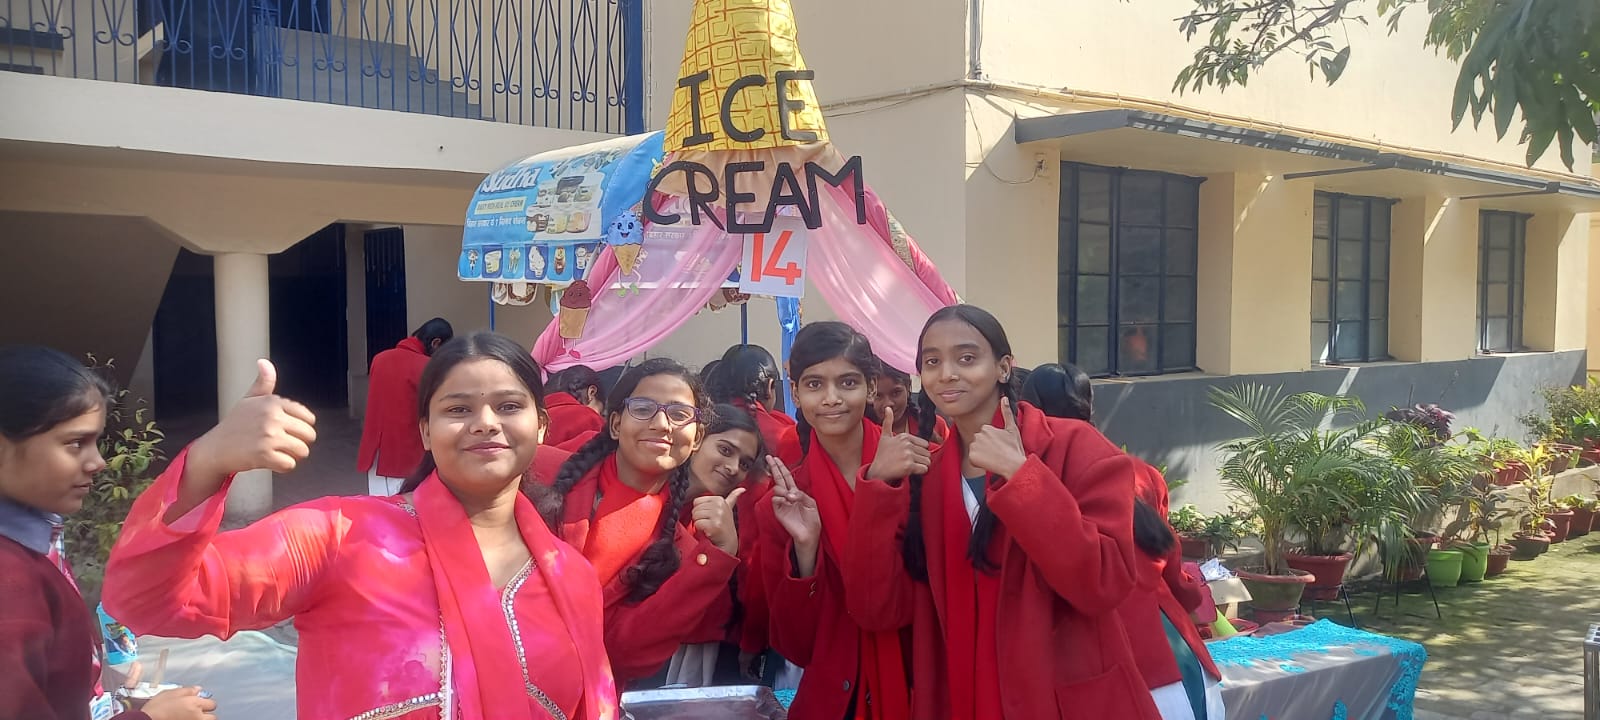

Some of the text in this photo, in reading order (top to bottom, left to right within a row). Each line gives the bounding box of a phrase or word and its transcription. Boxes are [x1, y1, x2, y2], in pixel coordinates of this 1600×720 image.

[679, 70, 818, 147] ICE
[480, 167, 540, 193] Sudha
[642, 156, 866, 234] CREAM
[751, 230, 802, 286] 14
